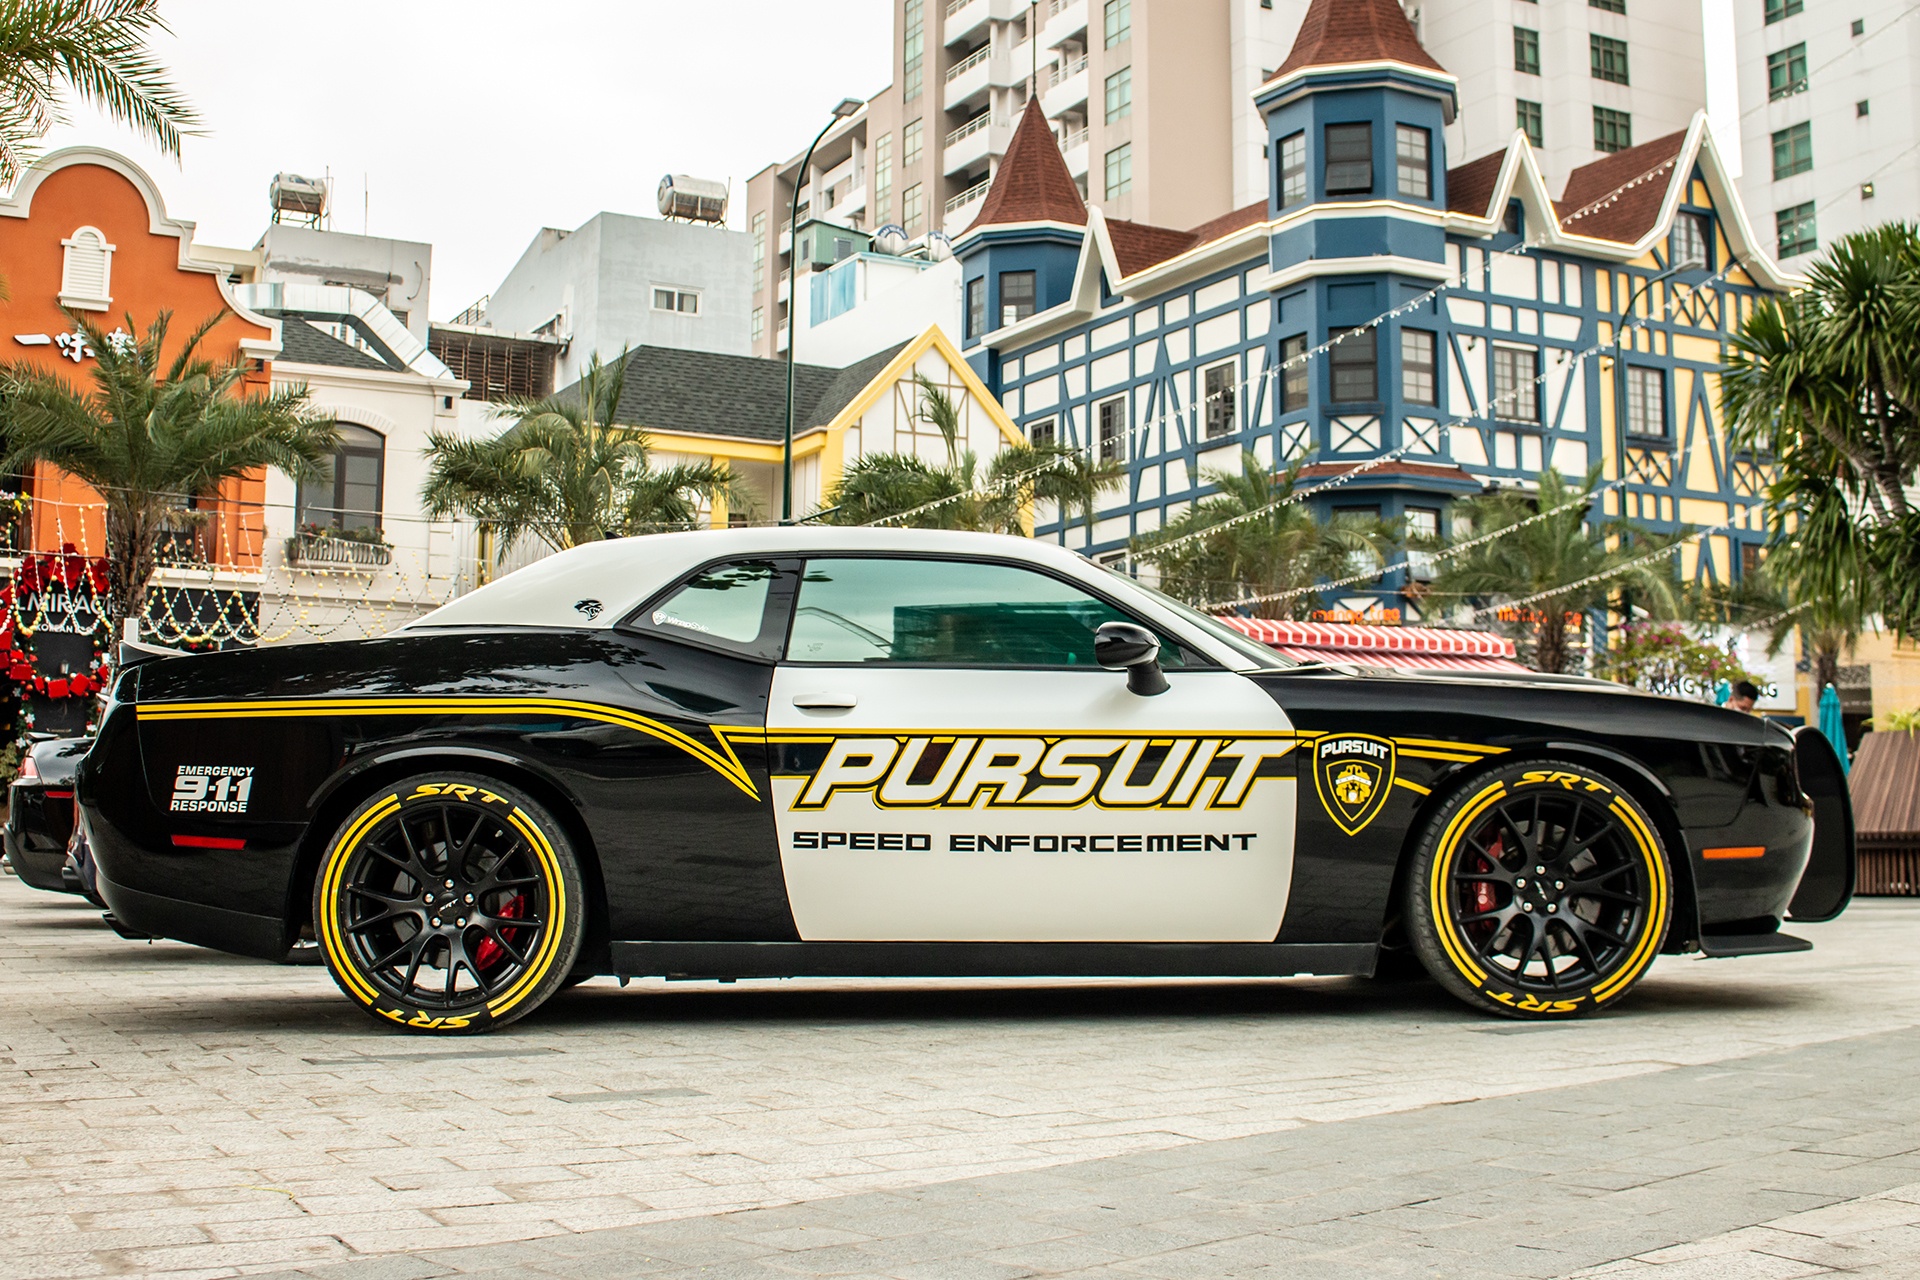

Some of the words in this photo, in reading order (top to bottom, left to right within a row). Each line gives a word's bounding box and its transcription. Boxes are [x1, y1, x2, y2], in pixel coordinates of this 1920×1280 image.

[1370, 604, 1400, 621] tree
[1320, 740, 1389, 759] PURSUIT
[177, 765, 255, 776] EMERGENCY
[788, 736, 1306, 811] PURSUIT
[1513, 771, 1611, 794] SRT
[406, 783, 508, 804] SRT
[169, 800, 248, 813] RESPONSE
[793, 832, 931, 851] SPEED
[949, 834, 1257, 852] ENFORCEMENT
[1486, 990, 1586, 1012] SRT
[376, 1008, 480, 1029] SRT
